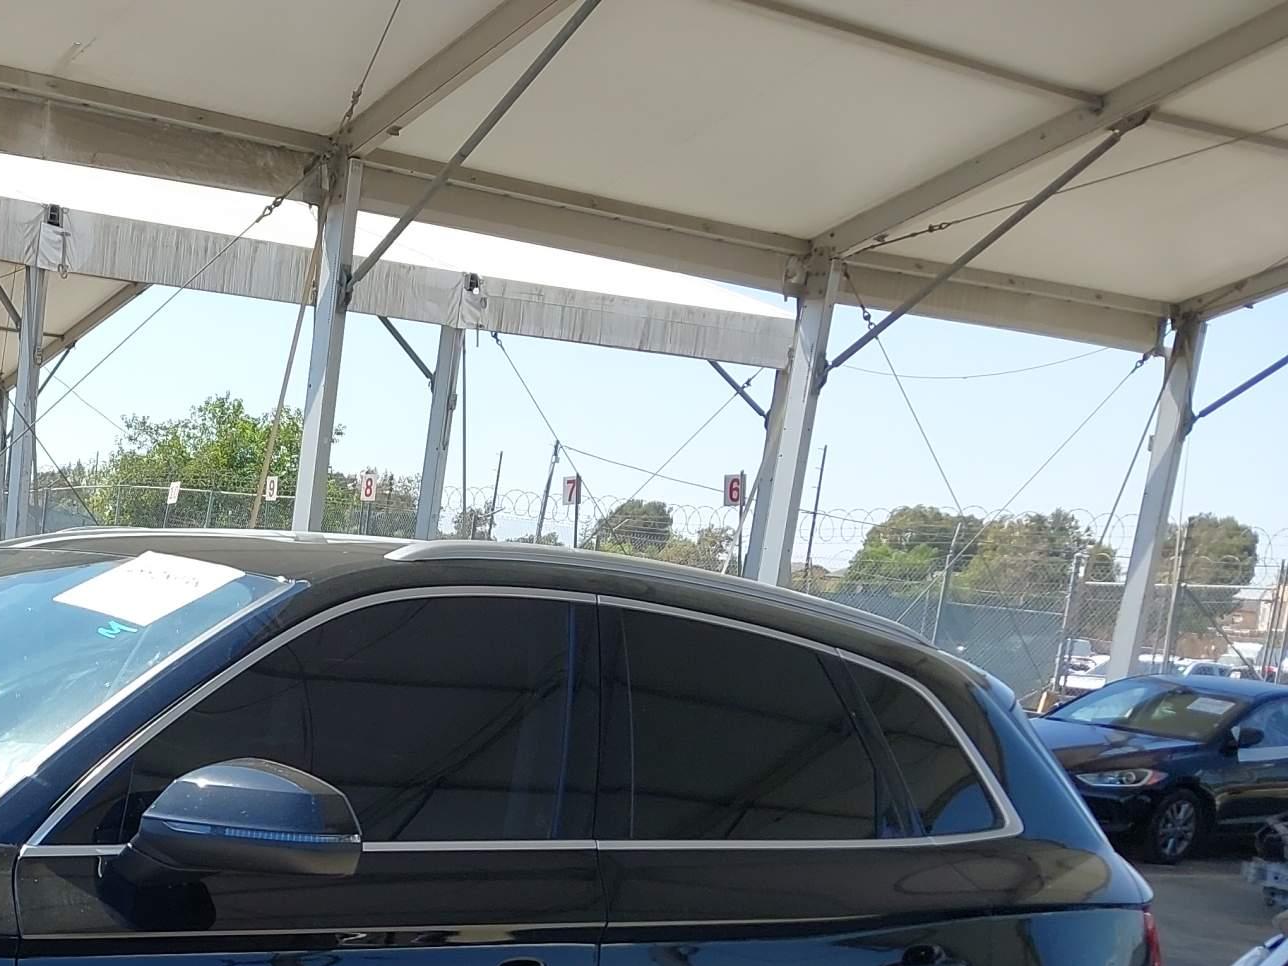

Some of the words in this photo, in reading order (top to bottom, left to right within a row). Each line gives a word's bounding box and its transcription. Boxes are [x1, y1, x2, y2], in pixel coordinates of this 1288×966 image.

[268, 479, 275, 497] 9
[365, 478, 373, 497] 8
[567, 480, 576, 502] 7
[729, 478, 740, 502] 6
